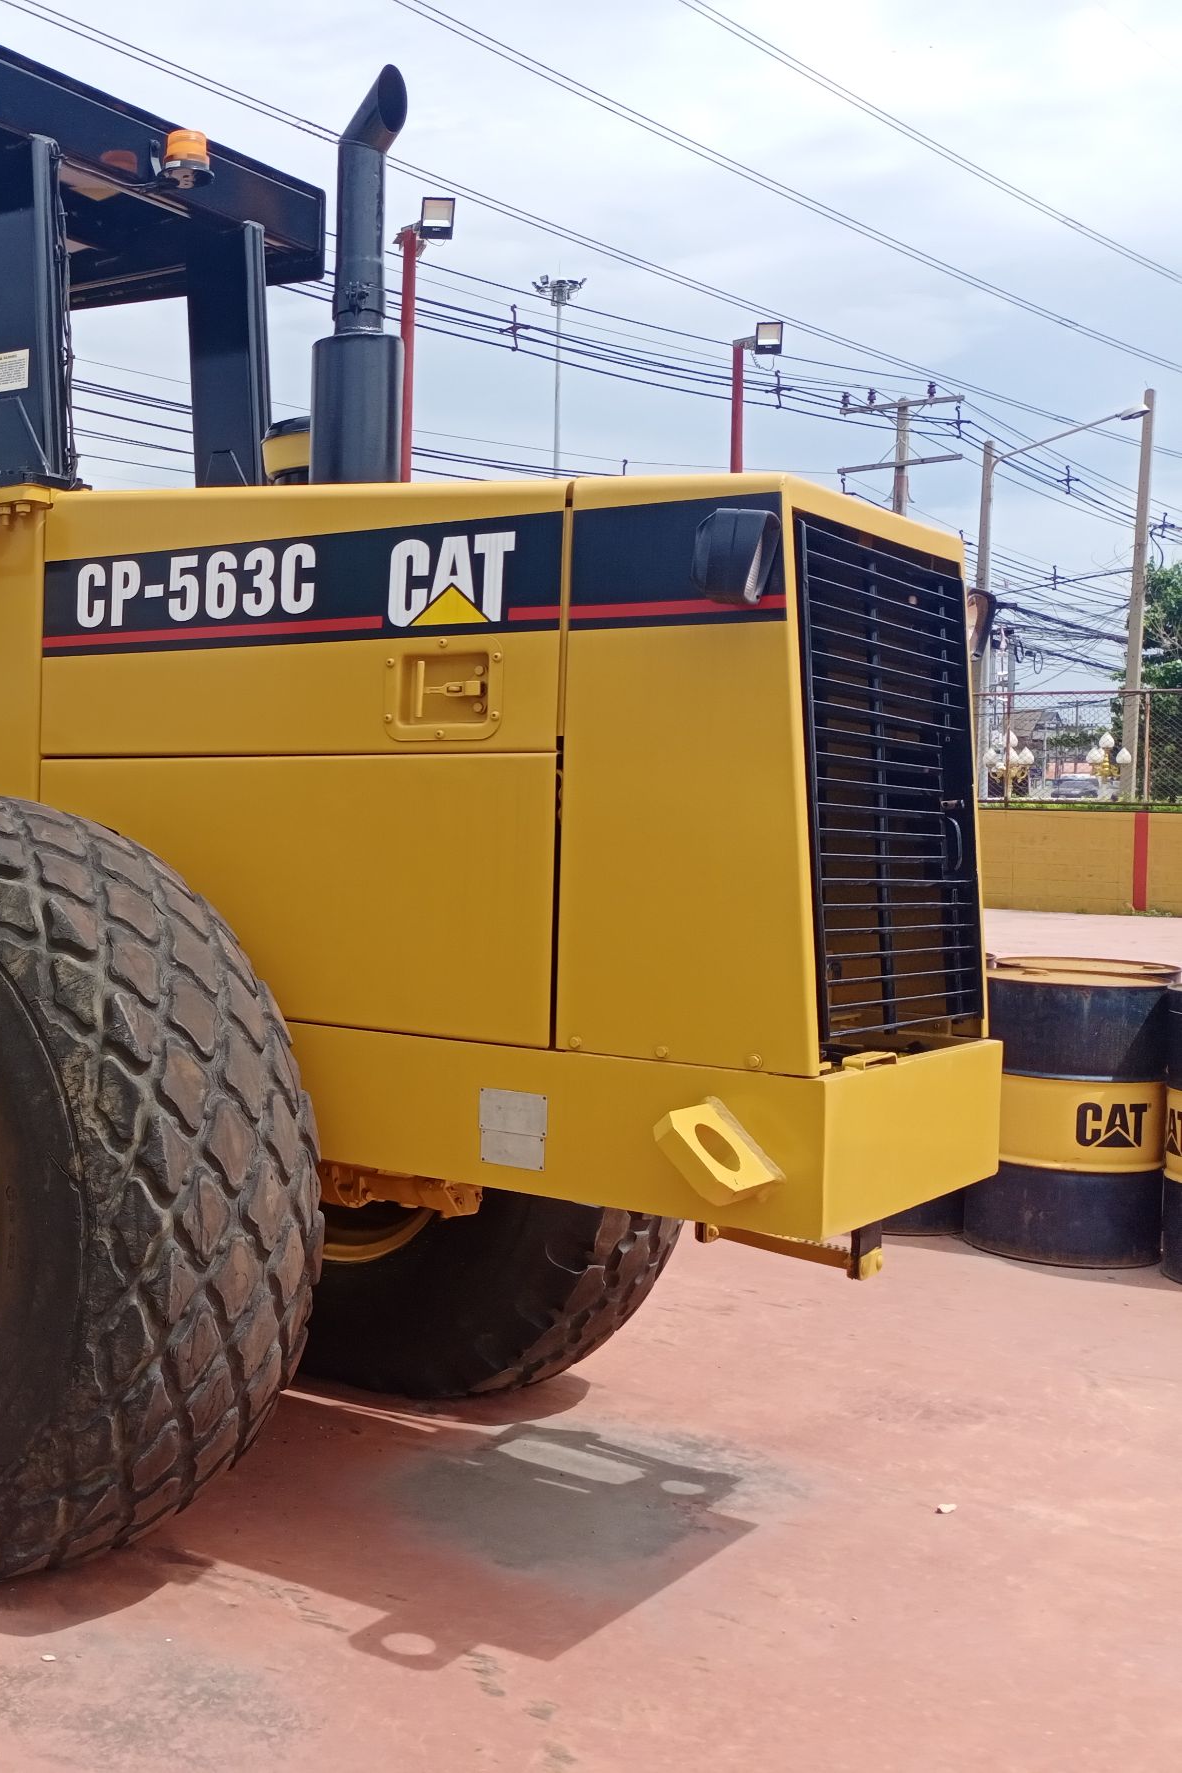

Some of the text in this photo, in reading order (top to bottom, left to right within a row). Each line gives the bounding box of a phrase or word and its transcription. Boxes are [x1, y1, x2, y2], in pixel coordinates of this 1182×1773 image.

[76, 531, 516, 628] CP-563C CAT
[1075, 1102, 1146, 1148] CAT
